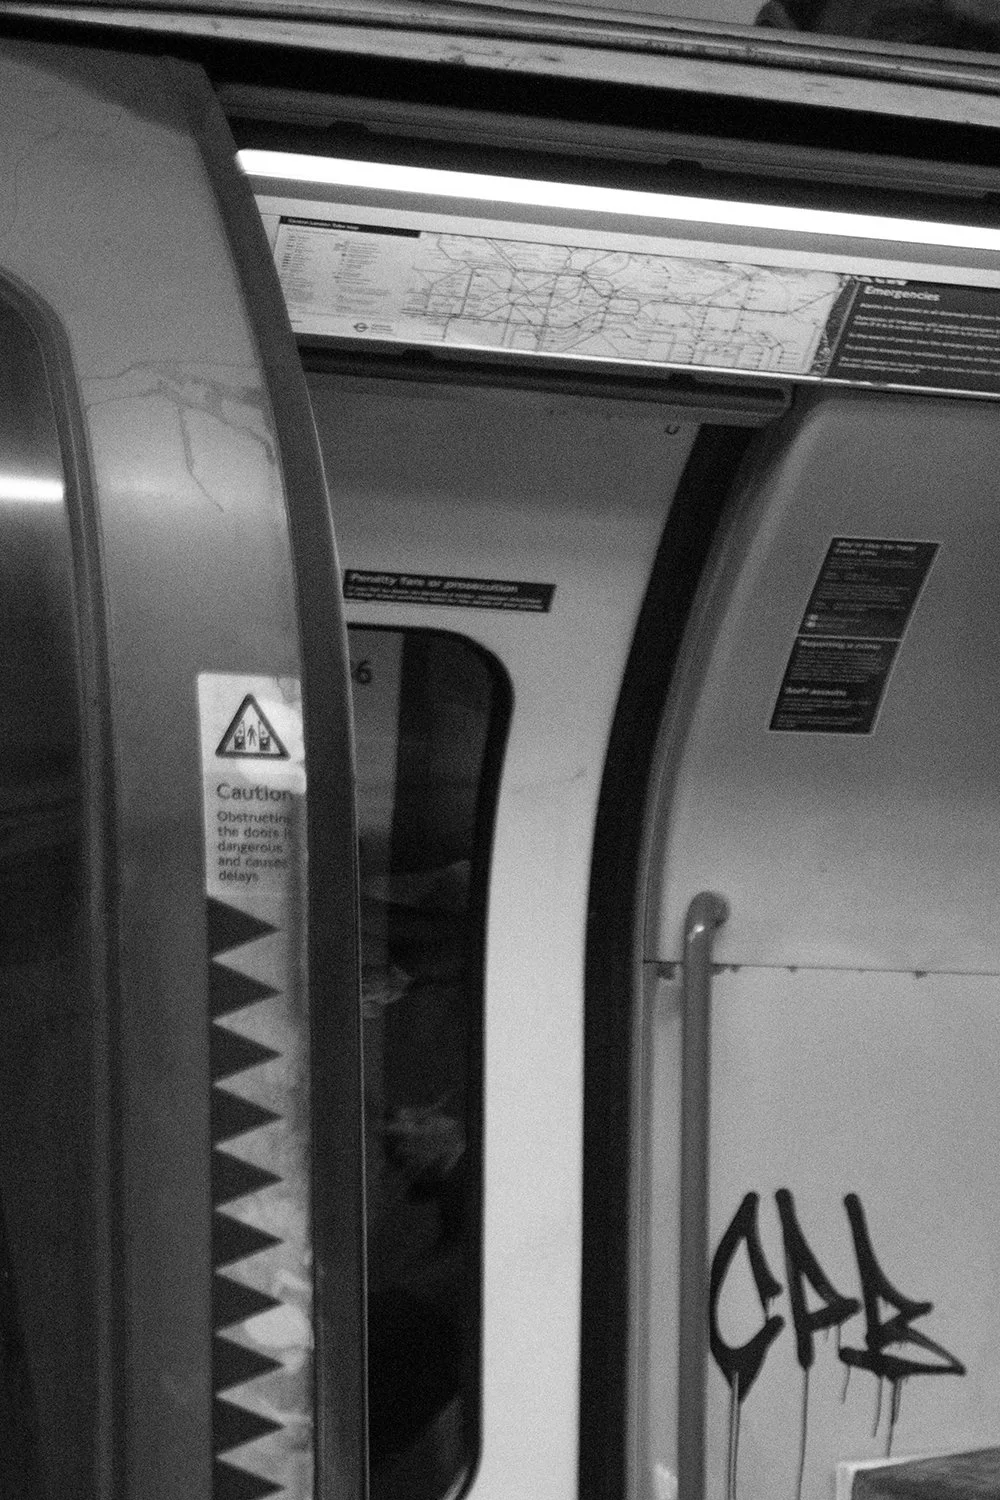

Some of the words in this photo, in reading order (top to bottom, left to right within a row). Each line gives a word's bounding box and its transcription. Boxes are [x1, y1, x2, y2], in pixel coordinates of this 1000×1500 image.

[863, 284, 941, 302] Emergencies
[350, 572, 398, 587] Penalty
[216, 782, 295, 802] Caution
[217, 825, 240, 838] the
[243, 826, 281, 839] doors
[217, 840, 284, 855] dangerous
[218, 856, 242, 868] and
[218, 870, 260, 885] delays
